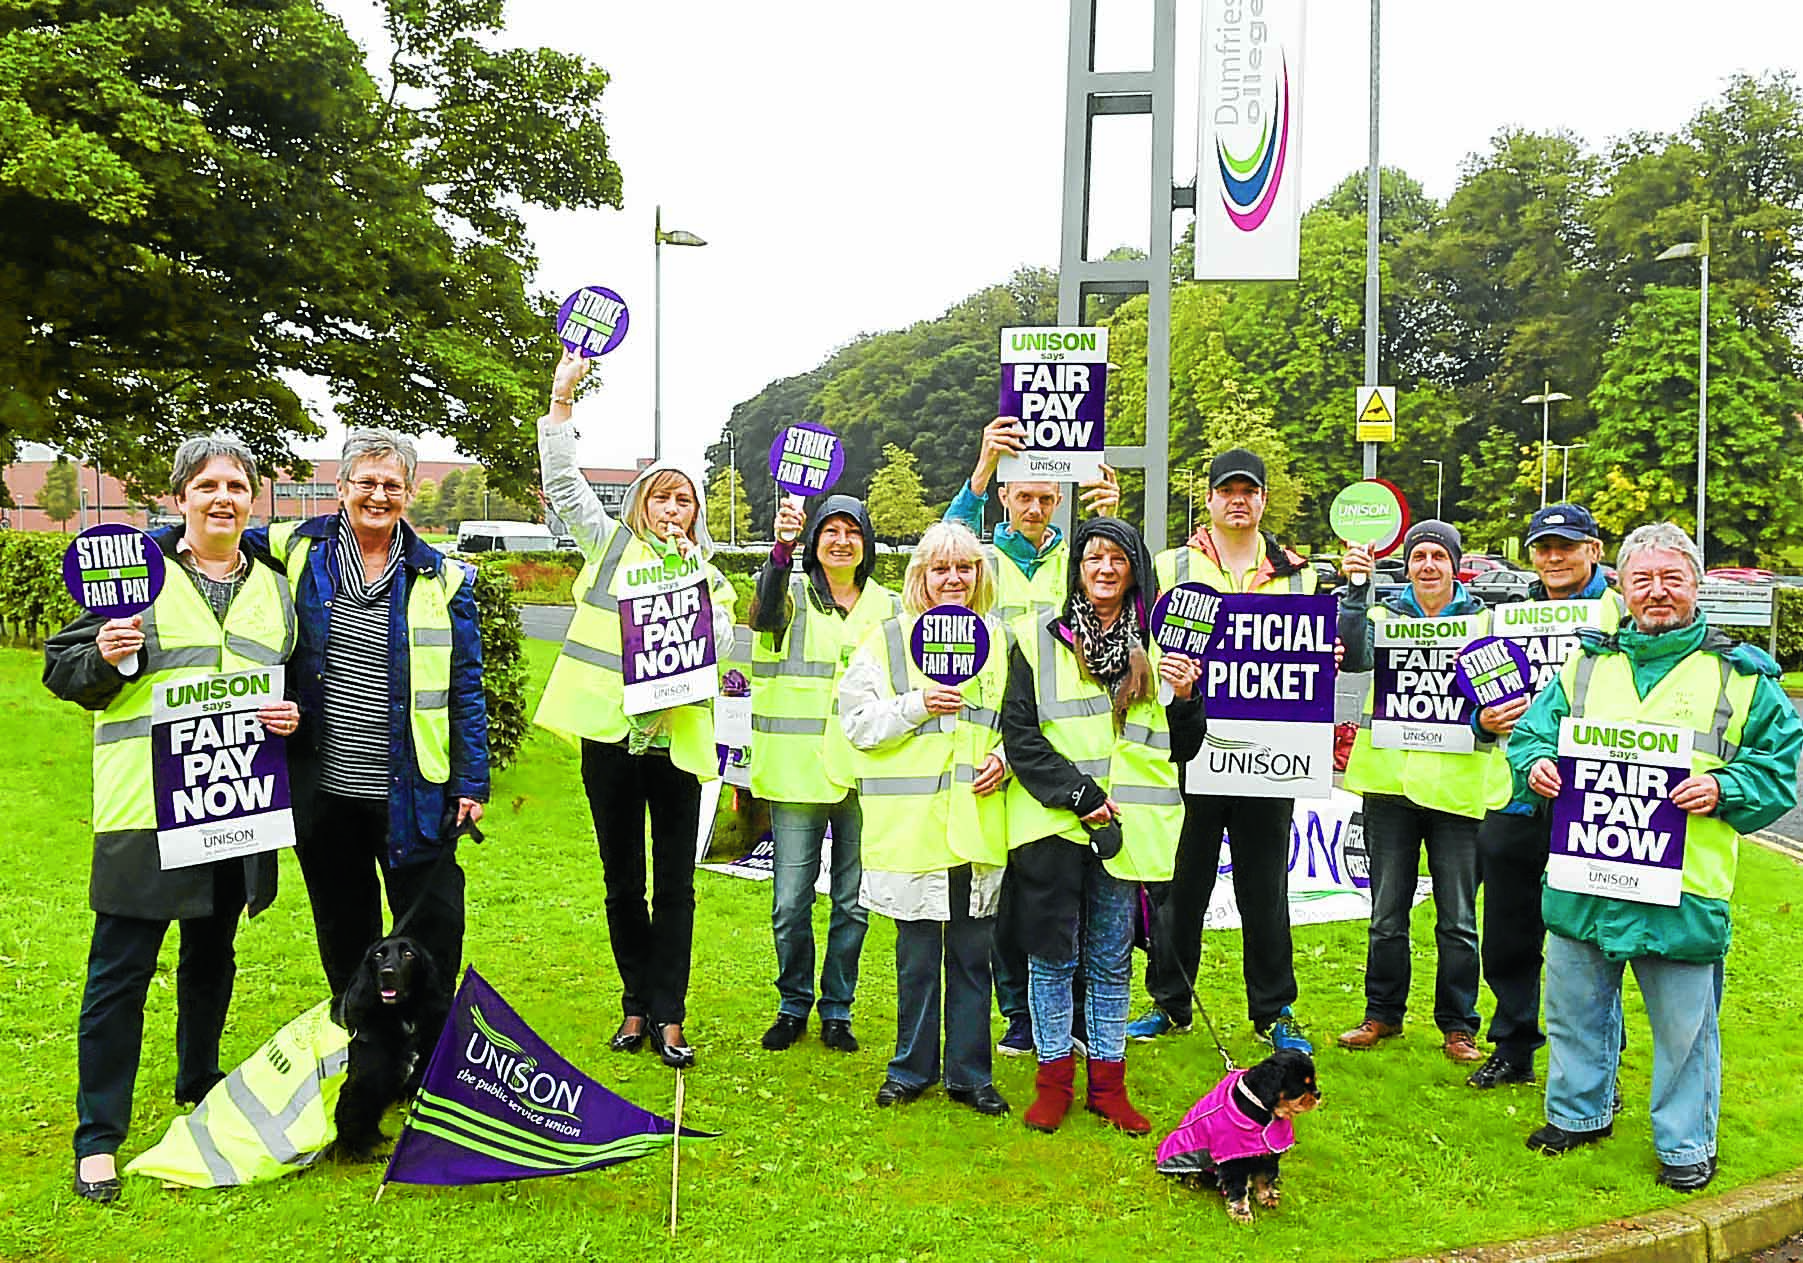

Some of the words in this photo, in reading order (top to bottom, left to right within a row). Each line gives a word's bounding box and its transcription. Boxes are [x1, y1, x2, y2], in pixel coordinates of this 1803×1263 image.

[572, 288, 626, 328] STRIKE
[560, 320, 588, 346] FAIR
[584, 330, 611, 354] PAY
[1011, 333, 1096, 351] UNISON
[1040, 352, 1065, 360] says
[1013, 364, 1090, 392] FAIR
[1022, 393, 1085, 420] PAY
[784, 427, 837, 460] STRIKE
[776, 461, 804, 485] FAIR
[803, 467, 828, 490] PAY
[1030, 461, 1071, 472] UNISON
[1338, 503, 1390, 516] UNISON
[76, 533, 147, 570] STRIKE
[83, 581, 118, 607] FAIR
[121, 578, 150, 604] PAY
[633, 586, 701, 627] FAIR
[1167, 587, 1223, 625] STRIKE
[922, 614, 977, 643] STRIKE
[1385, 621, 1467, 639] UNISON
[1504, 606, 1589, 625] UNISON
[644, 613, 698, 651] PAY
[1157, 623, 1186, 649] FAIR
[1185, 631, 1210, 655] PAY
[635, 637, 707, 680] NOW
[923, 653, 949, 675] FAIR
[953, 654, 975, 676] PAY
[1389, 649, 1457, 671] FAIR
[1459, 638, 1514, 679] STRIKE
[165, 673, 270, 708] UNISON
[1207, 660, 1320, 701] PICKET
[1396, 671, 1457, 695] PAY
[1474, 680, 1504, 706] FAIR
[1501, 669, 1525, 694] PAY
[202, 701, 232, 712] says
[1385, 693, 1466, 721] NOW
[170, 711, 266, 755] FAIR
[1403, 731, 1442, 743] UNISON
[1572, 724, 1679, 753] UNISON
[183, 743, 261, 788] PAY
[1209, 751, 1311, 776] UNISON
[1609, 749, 1639, 760] says
[1574, 759, 1669, 799] FAIR
[172, 774, 275, 824] NOW
[1583, 791, 1662, 829] PAY
[203, 828, 254, 848] UNISON
[1567, 821, 1672, 863] NOW
[1589, 871, 1640, 888] UNISON
[465, 1032, 583, 1115] UNISON
[456, 1068, 477, 1084] the
[475, 1078, 509, 1103] public
[508, 1099, 545, 1125] service
[544, 1119, 581, 1138] union
